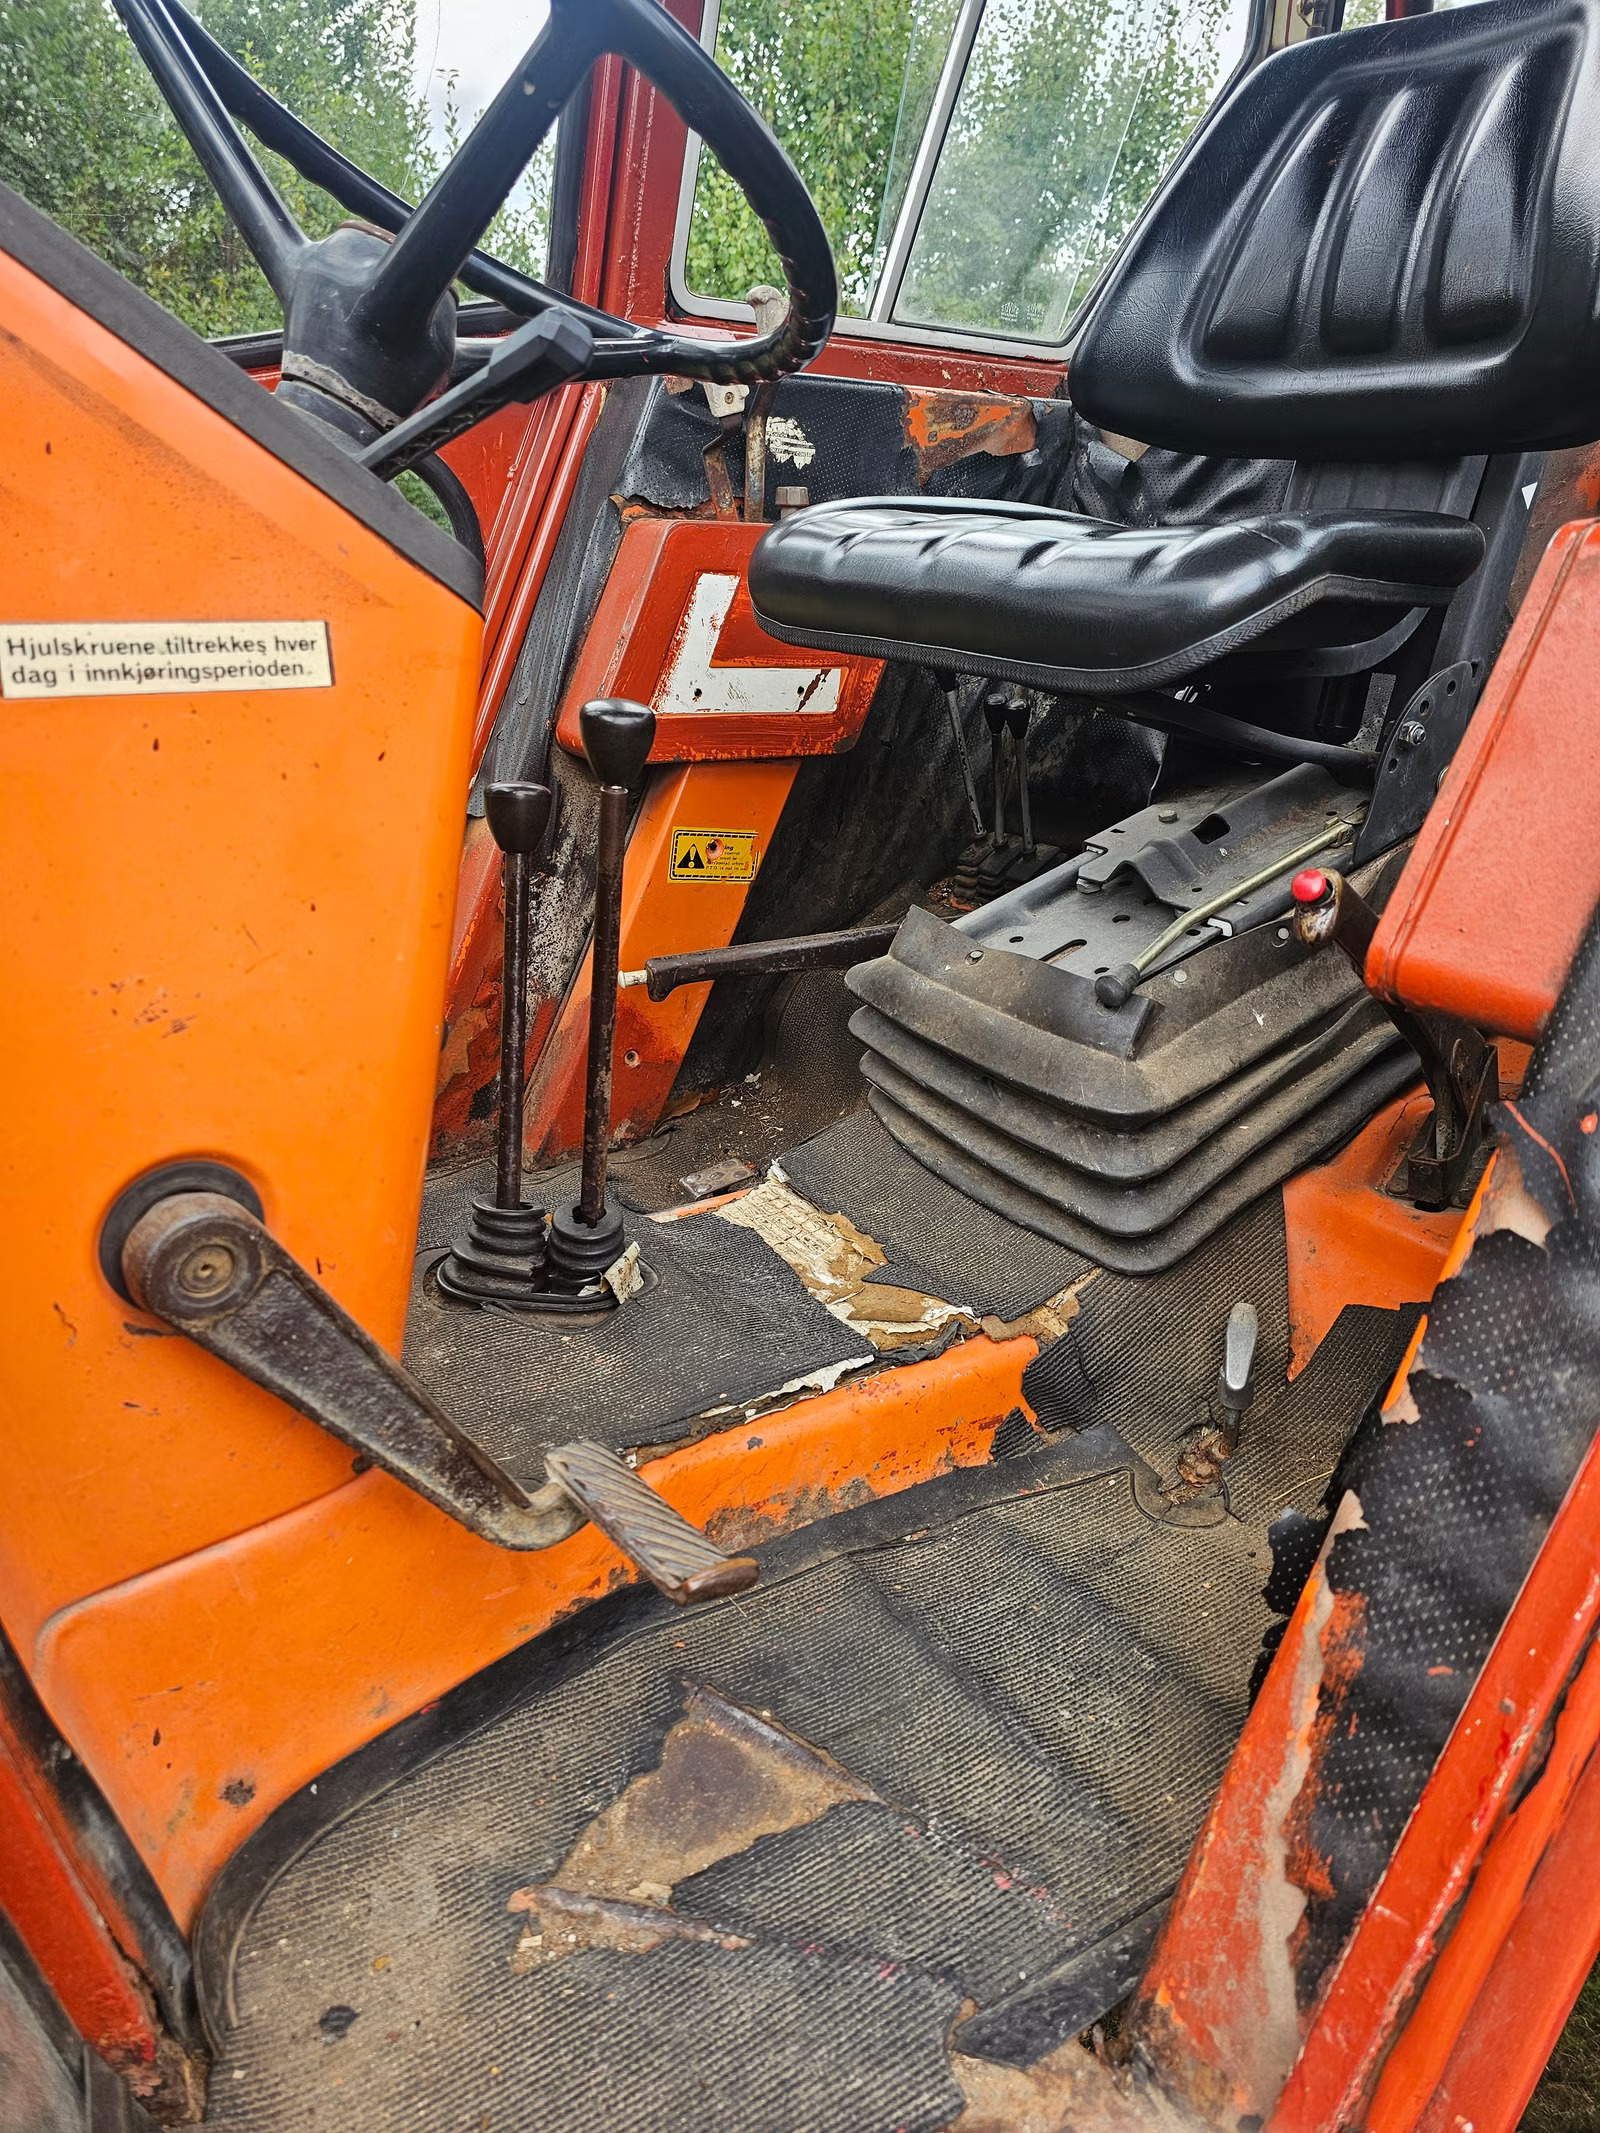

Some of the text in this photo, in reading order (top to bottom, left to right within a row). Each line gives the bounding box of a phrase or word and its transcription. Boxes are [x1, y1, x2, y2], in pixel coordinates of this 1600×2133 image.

[6, 635, 318, 660] Hjulskruene tiltrekkes hver
[11, 665, 58, 688] dag
[68, 663, 75, 682] i
